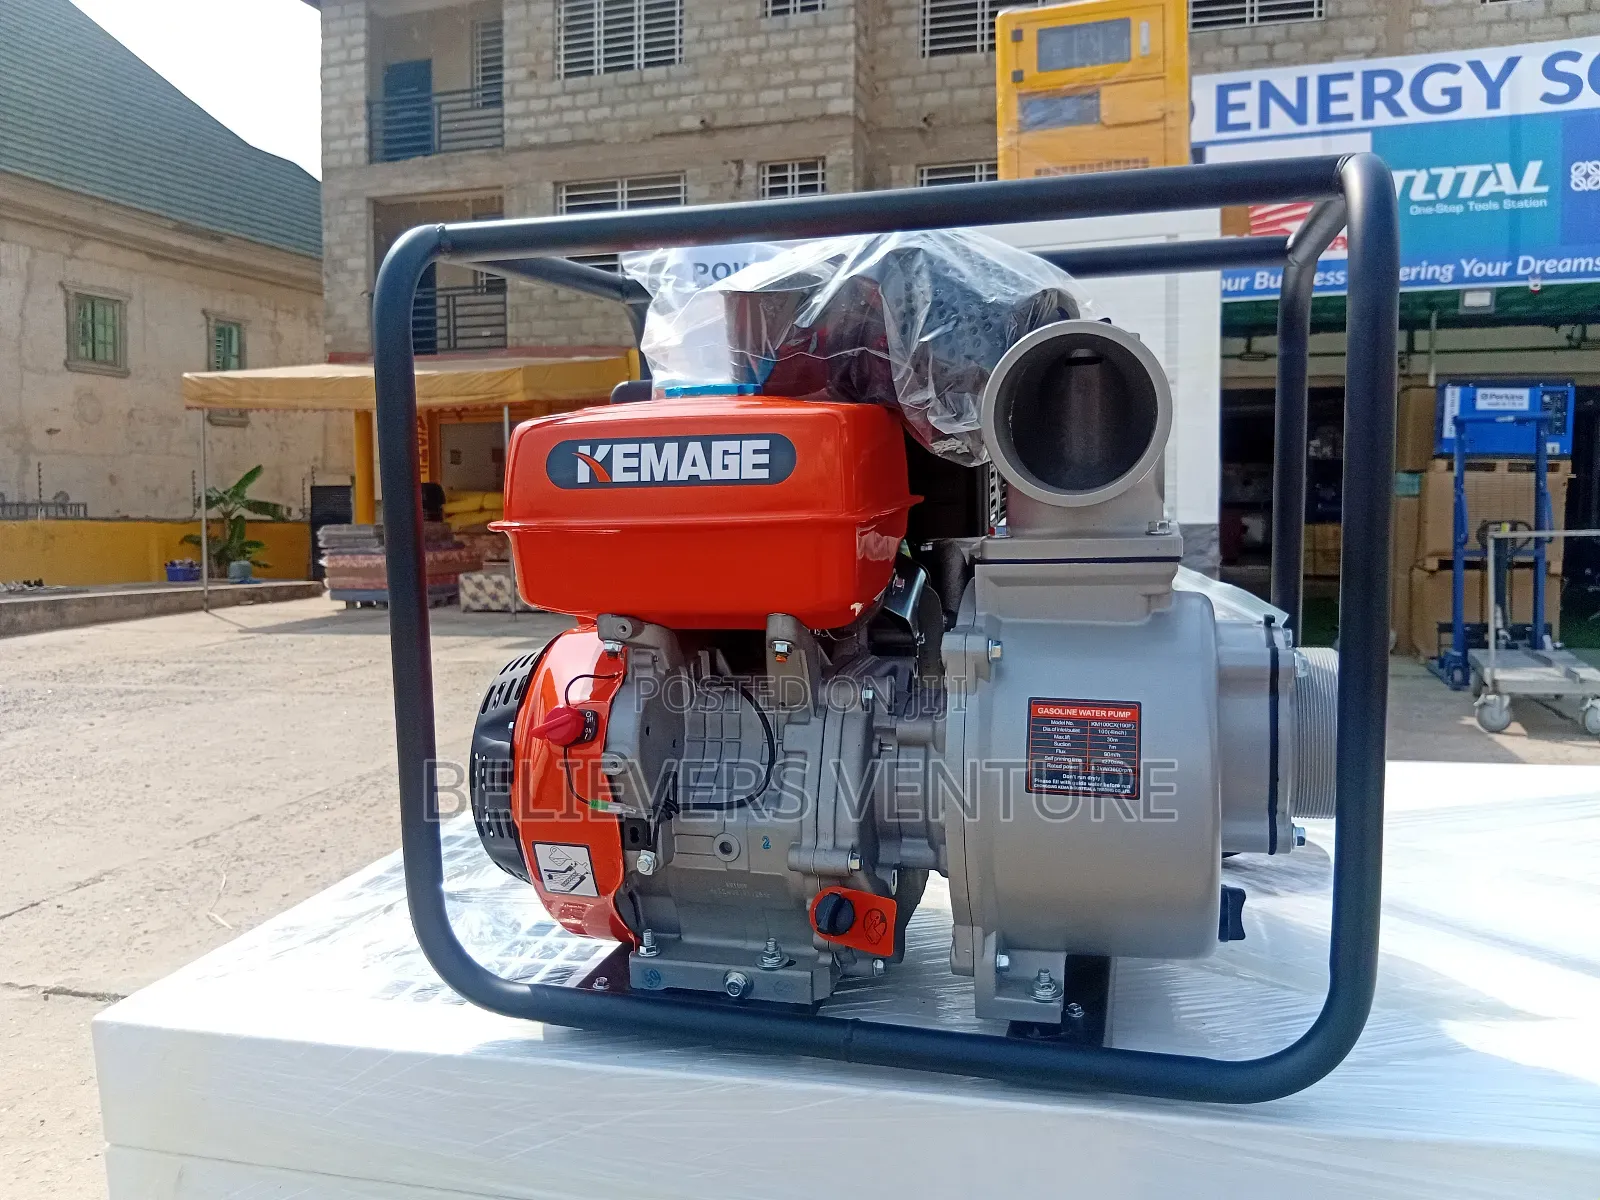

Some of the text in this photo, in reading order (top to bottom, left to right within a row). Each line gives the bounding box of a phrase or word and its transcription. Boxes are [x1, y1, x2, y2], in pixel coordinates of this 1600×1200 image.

[1215, 55, 1523, 133] ENERGY
[1539, 50, 1600, 105] S
[1391, 160, 1549, 201] TOTAL
[1467, 199, 1500, 212] Tools
[1503, 197, 1548, 210] Station
[1459, 257, 1513, 278] Your
[573, 439, 771, 484] KEMAGE
[1037, 707, 1078, 716] GASOLINE
[1078, 709, 1106, 717] WATER
[762, 836, 772, 850] 2
